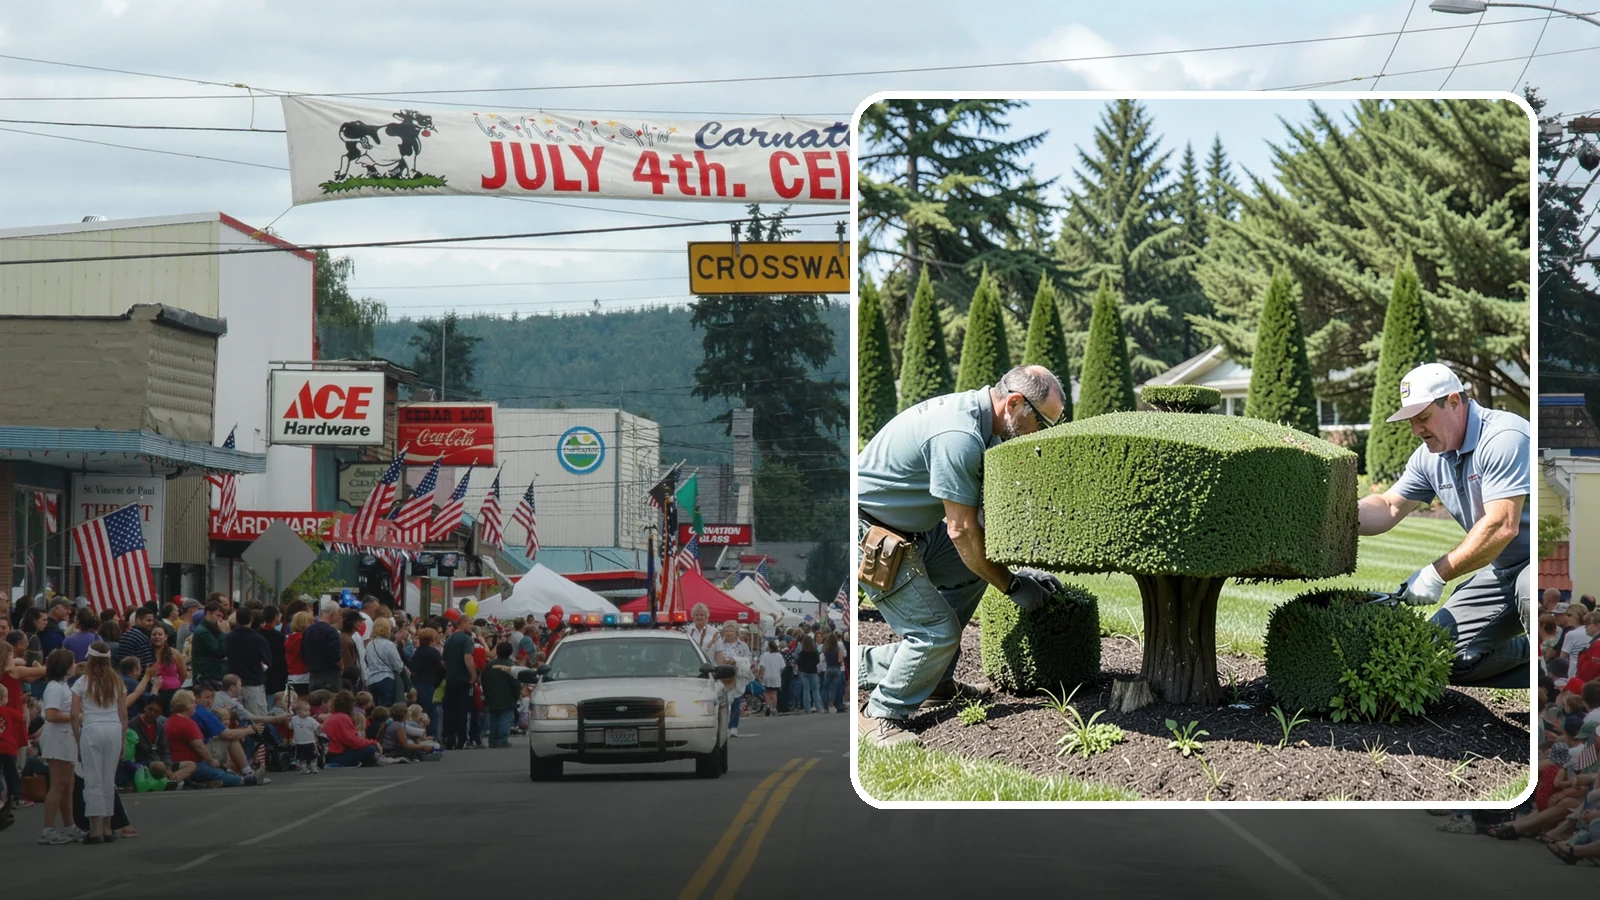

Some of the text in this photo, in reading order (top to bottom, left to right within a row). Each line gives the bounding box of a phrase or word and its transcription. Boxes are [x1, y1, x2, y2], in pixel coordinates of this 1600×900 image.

[481, 141, 605, 192] JULY
[632, 150, 746, 197] 4th.
[697, 254, 851, 280] CROSSWA
[283, 380, 373, 420] ACE
[406, 409, 485, 422] CEDAR LOG
[283, 421, 371, 437] Hardware
[416, 428, 477, 447] Coca-Cola
[83, 485, 155, 495] St. Vincent de Paul
[688, 526, 741, 535] CRNATION
[699, 535, 730, 543] GLASS
